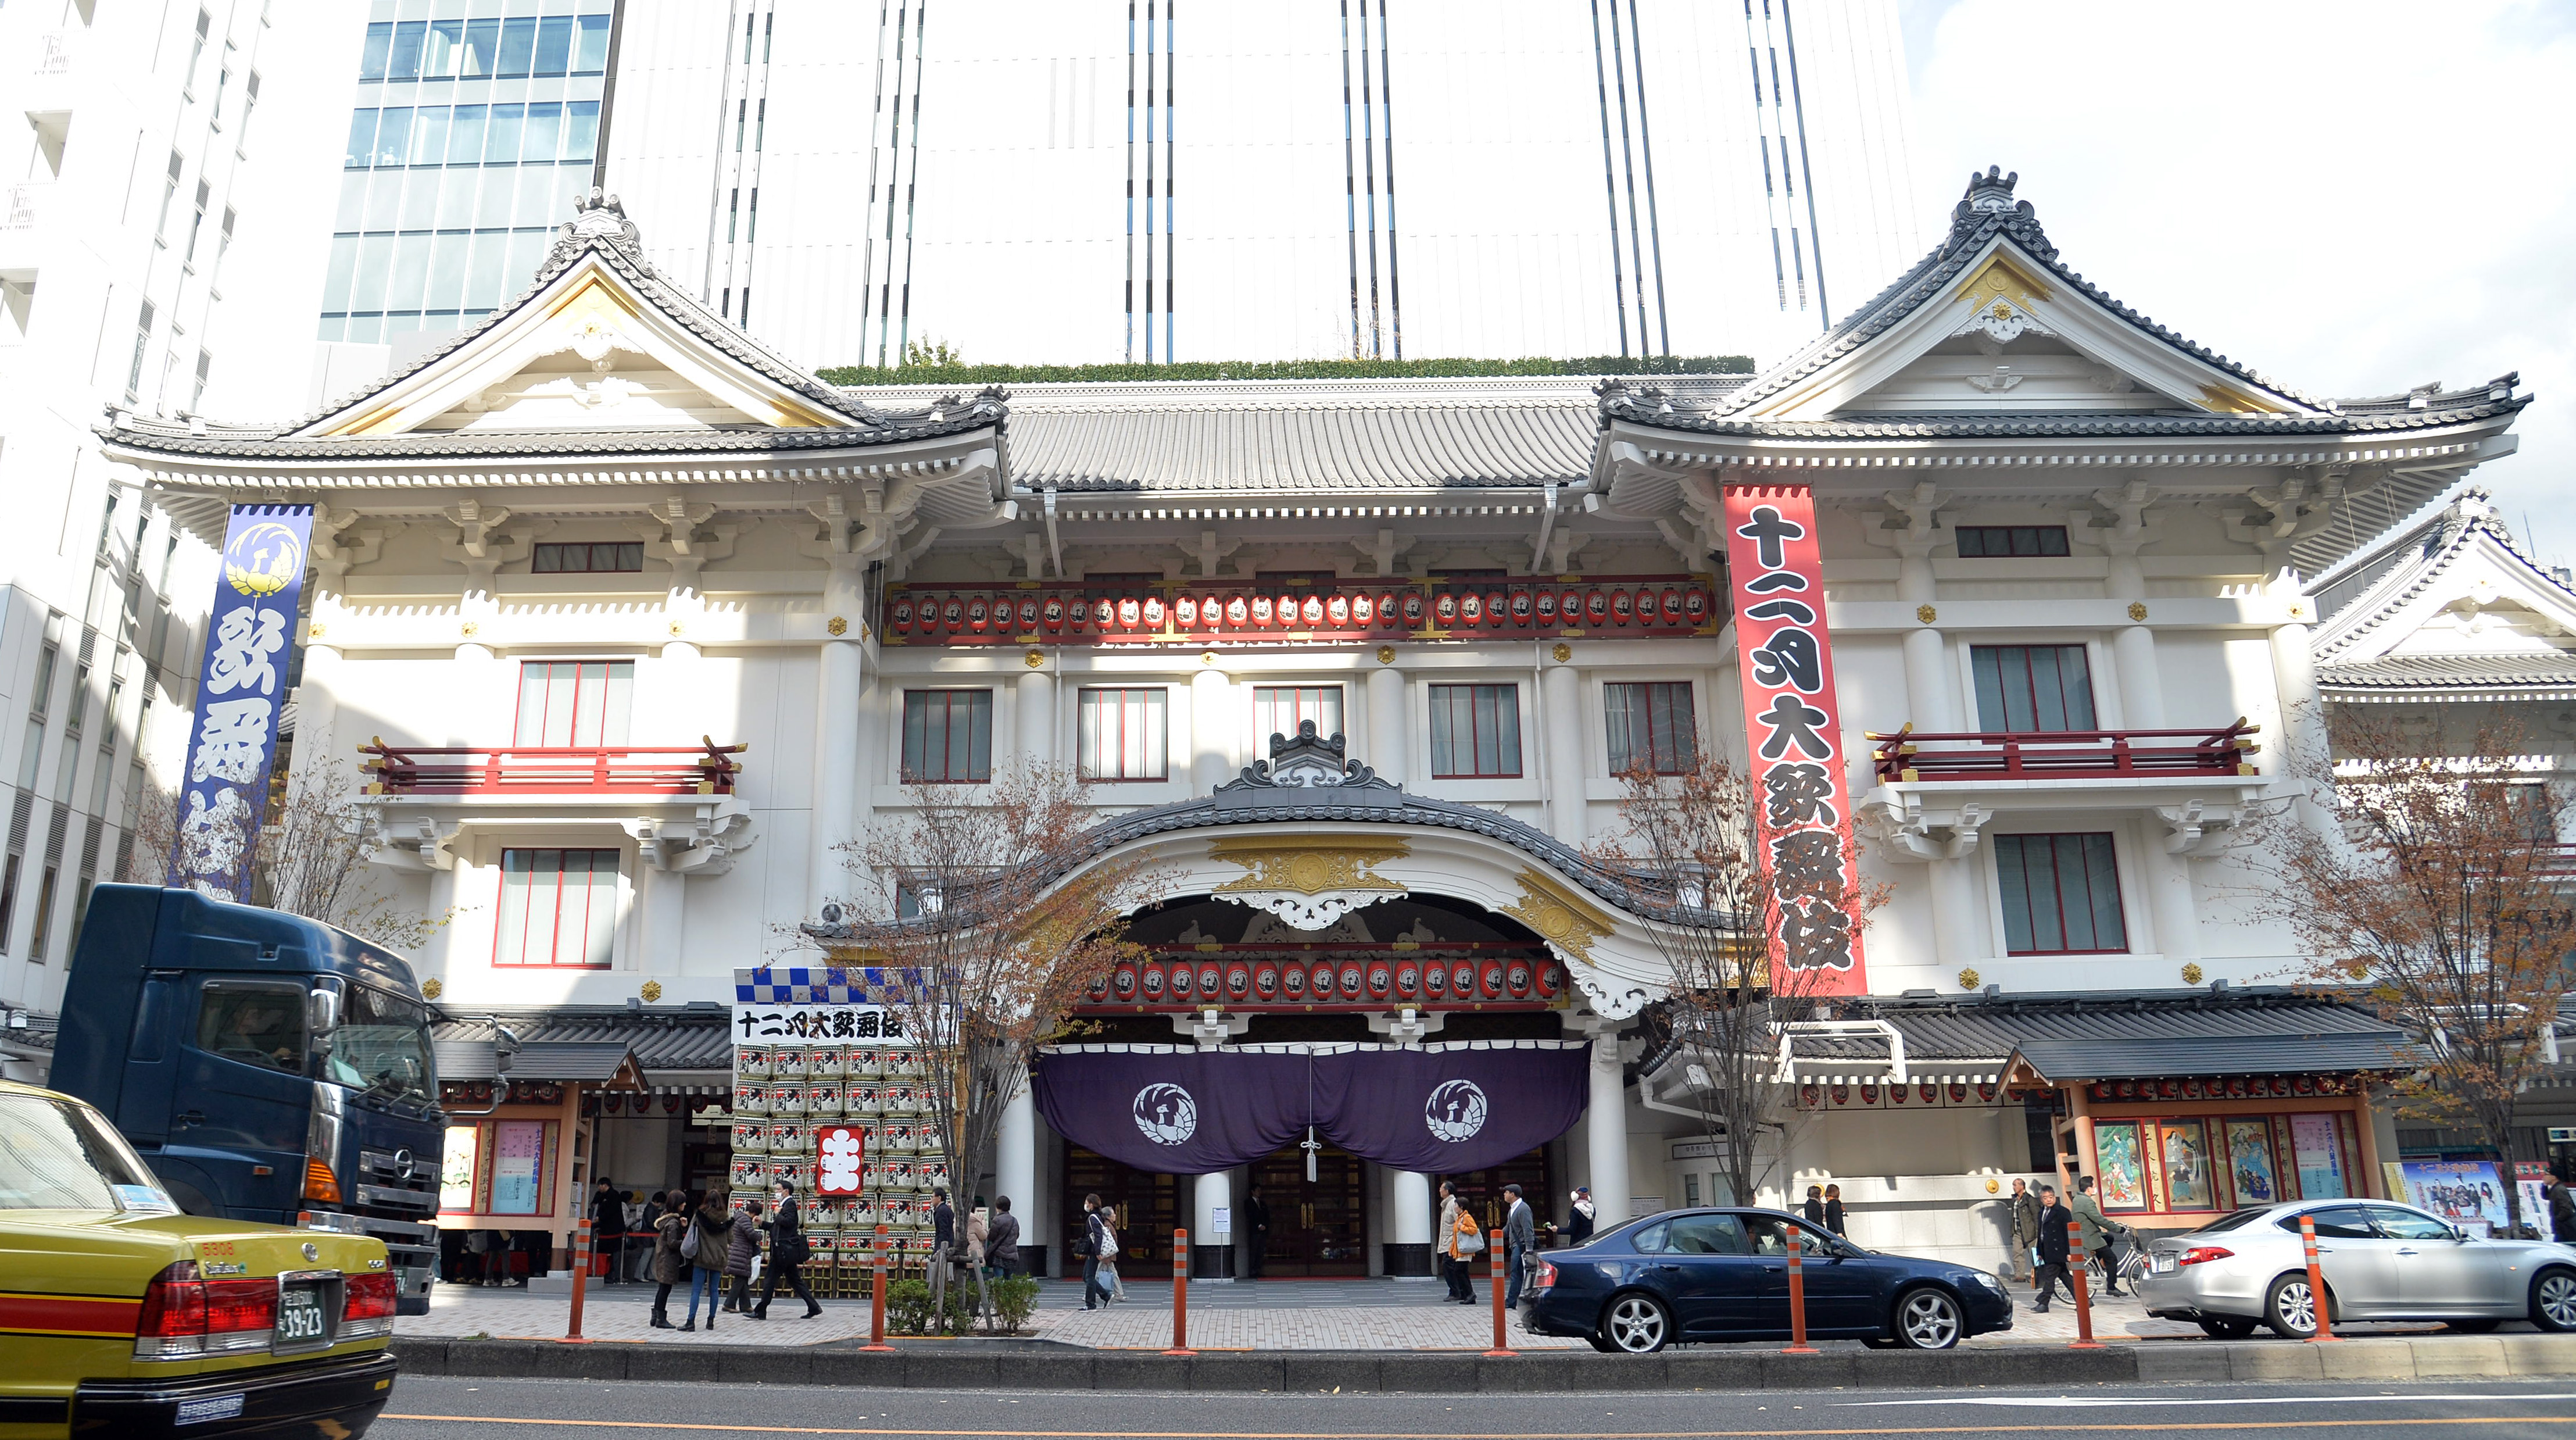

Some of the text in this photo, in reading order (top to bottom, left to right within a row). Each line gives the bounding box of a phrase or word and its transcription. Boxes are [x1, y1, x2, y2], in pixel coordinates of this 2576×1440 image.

[179, 606, 286, 901] 歌舞伎
[1736, 505, 1855, 971] 十二月大歌舞伎
[738, 1010, 904, 1039] 十二月大歌舞伎
[202, 1242, 234, 1256] 5308
[284, 1307, 323, 1338] 39-23
